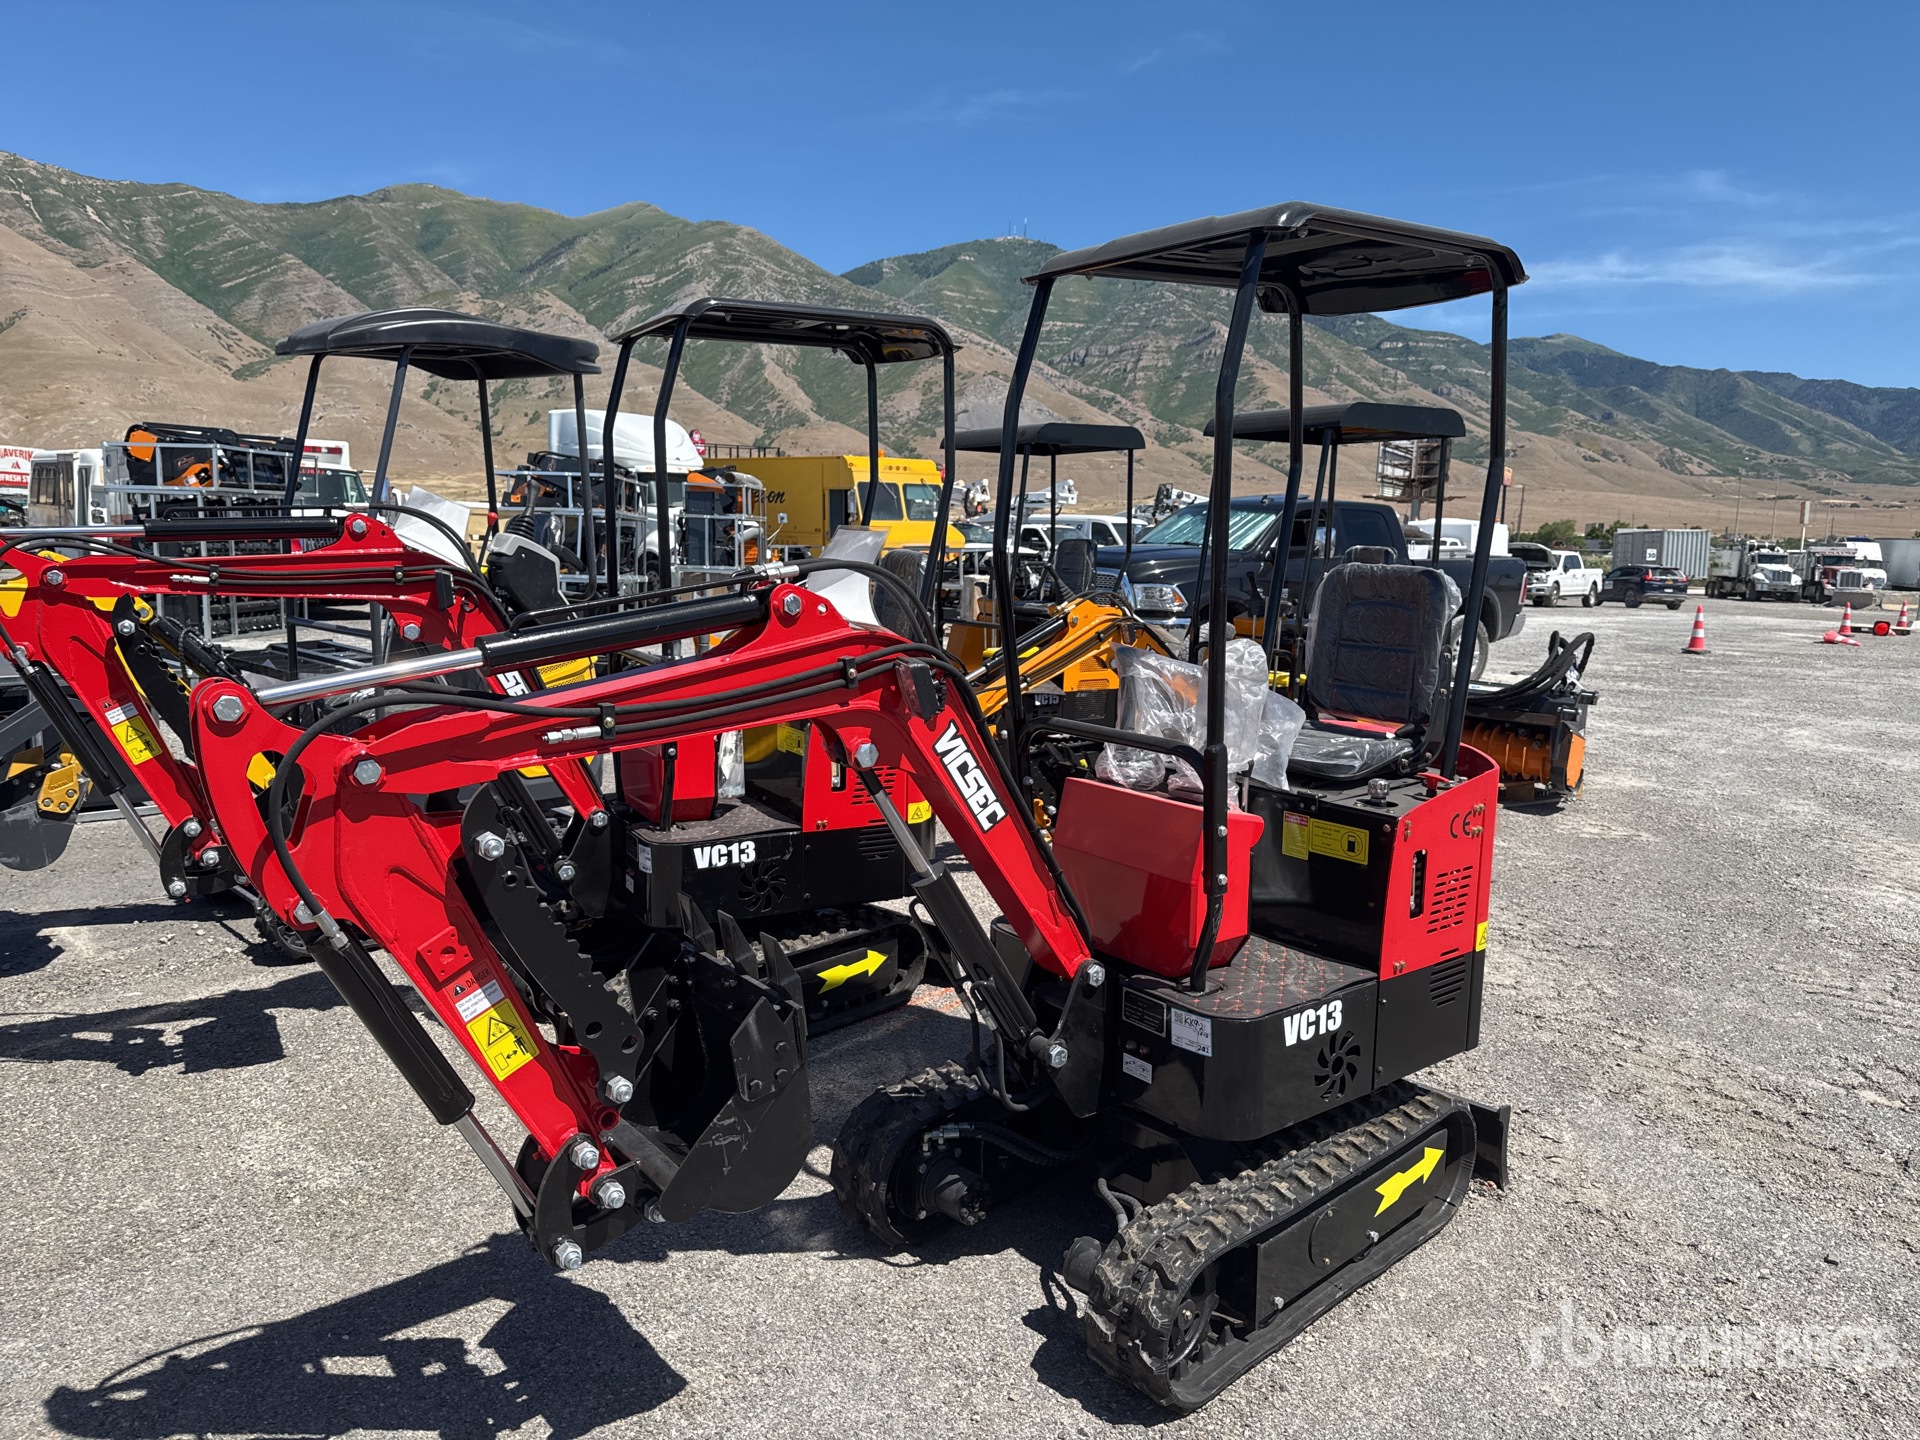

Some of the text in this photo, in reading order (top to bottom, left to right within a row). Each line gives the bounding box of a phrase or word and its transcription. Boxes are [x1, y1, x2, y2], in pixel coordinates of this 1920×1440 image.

[934, 720, 1007, 832] VICSEC
[693, 841, 756, 869] VC13
[466, 968, 492, 989] DANGER
[1283, 999, 1343, 1047] VC13
